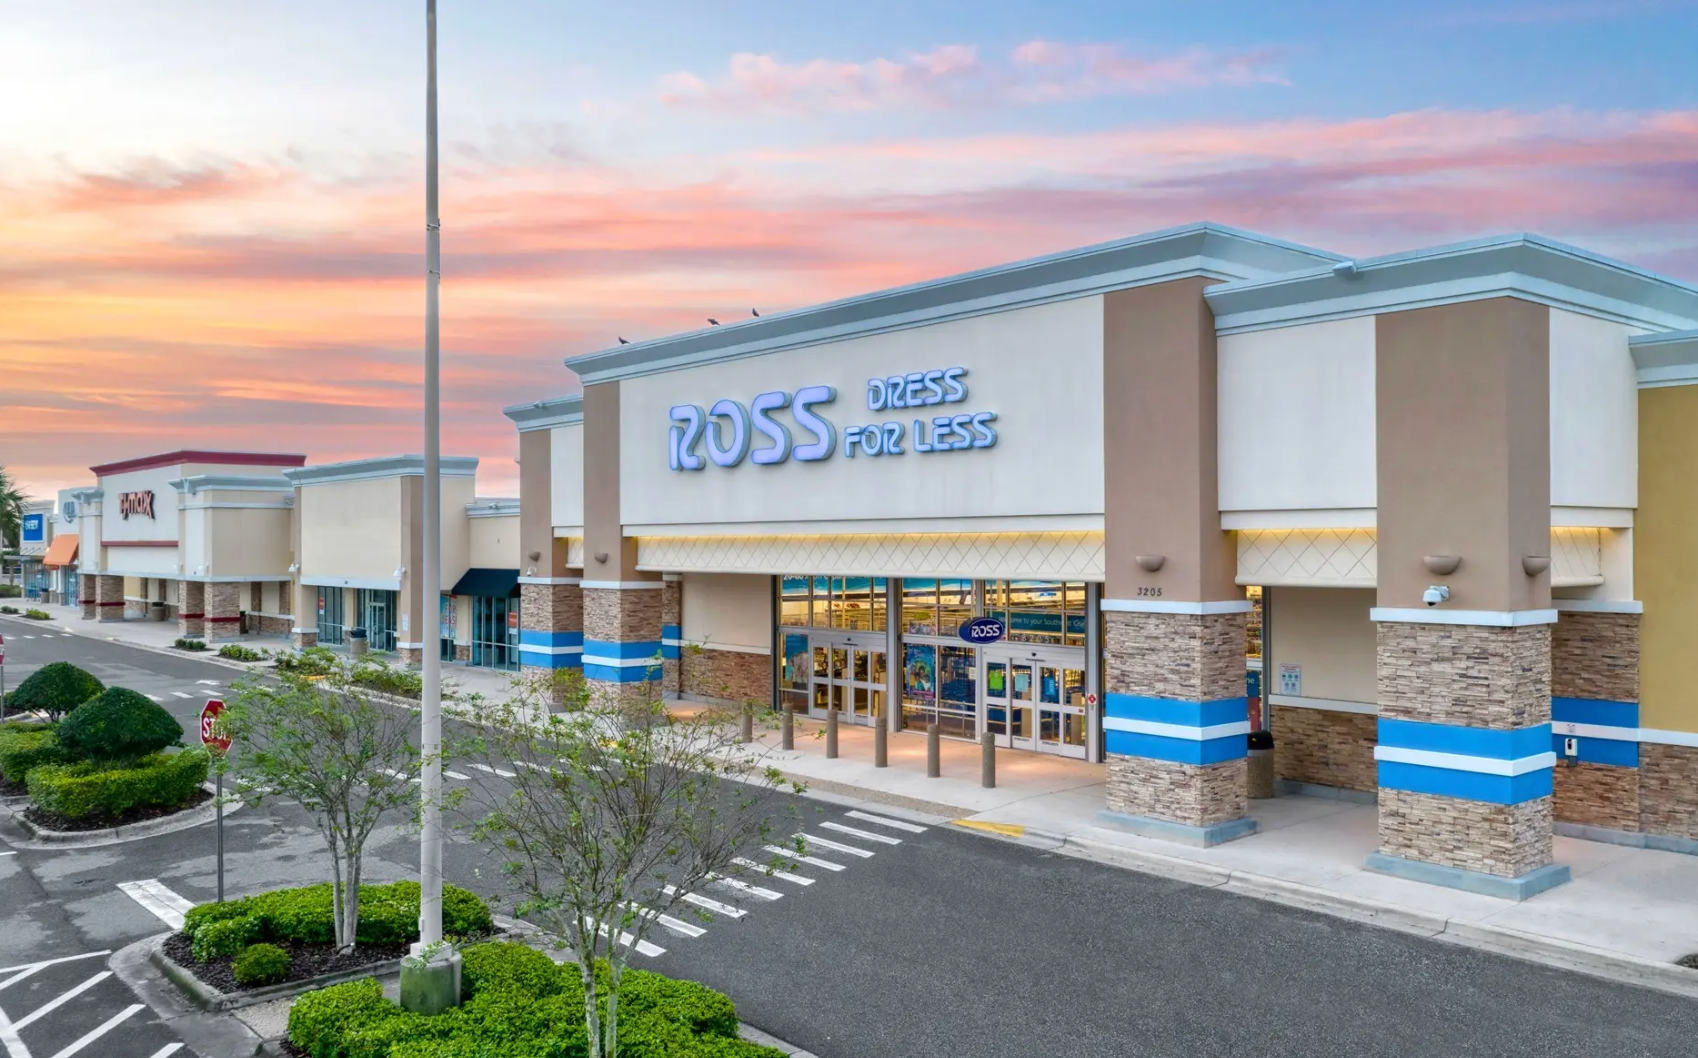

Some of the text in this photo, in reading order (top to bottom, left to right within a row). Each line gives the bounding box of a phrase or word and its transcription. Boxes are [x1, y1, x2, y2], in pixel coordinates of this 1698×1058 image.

[867, 367, 968, 411] DRESS
[669, 385, 837, 471] ROSS
[844, 411, 998, 458] FOR LESS
[1137, 587, 1162, 597] 3205
[971, 624, 1000, 638] ROSS
[1043, 618, 1072, 627] Southwst
[203, 717, 229, 740] ST
